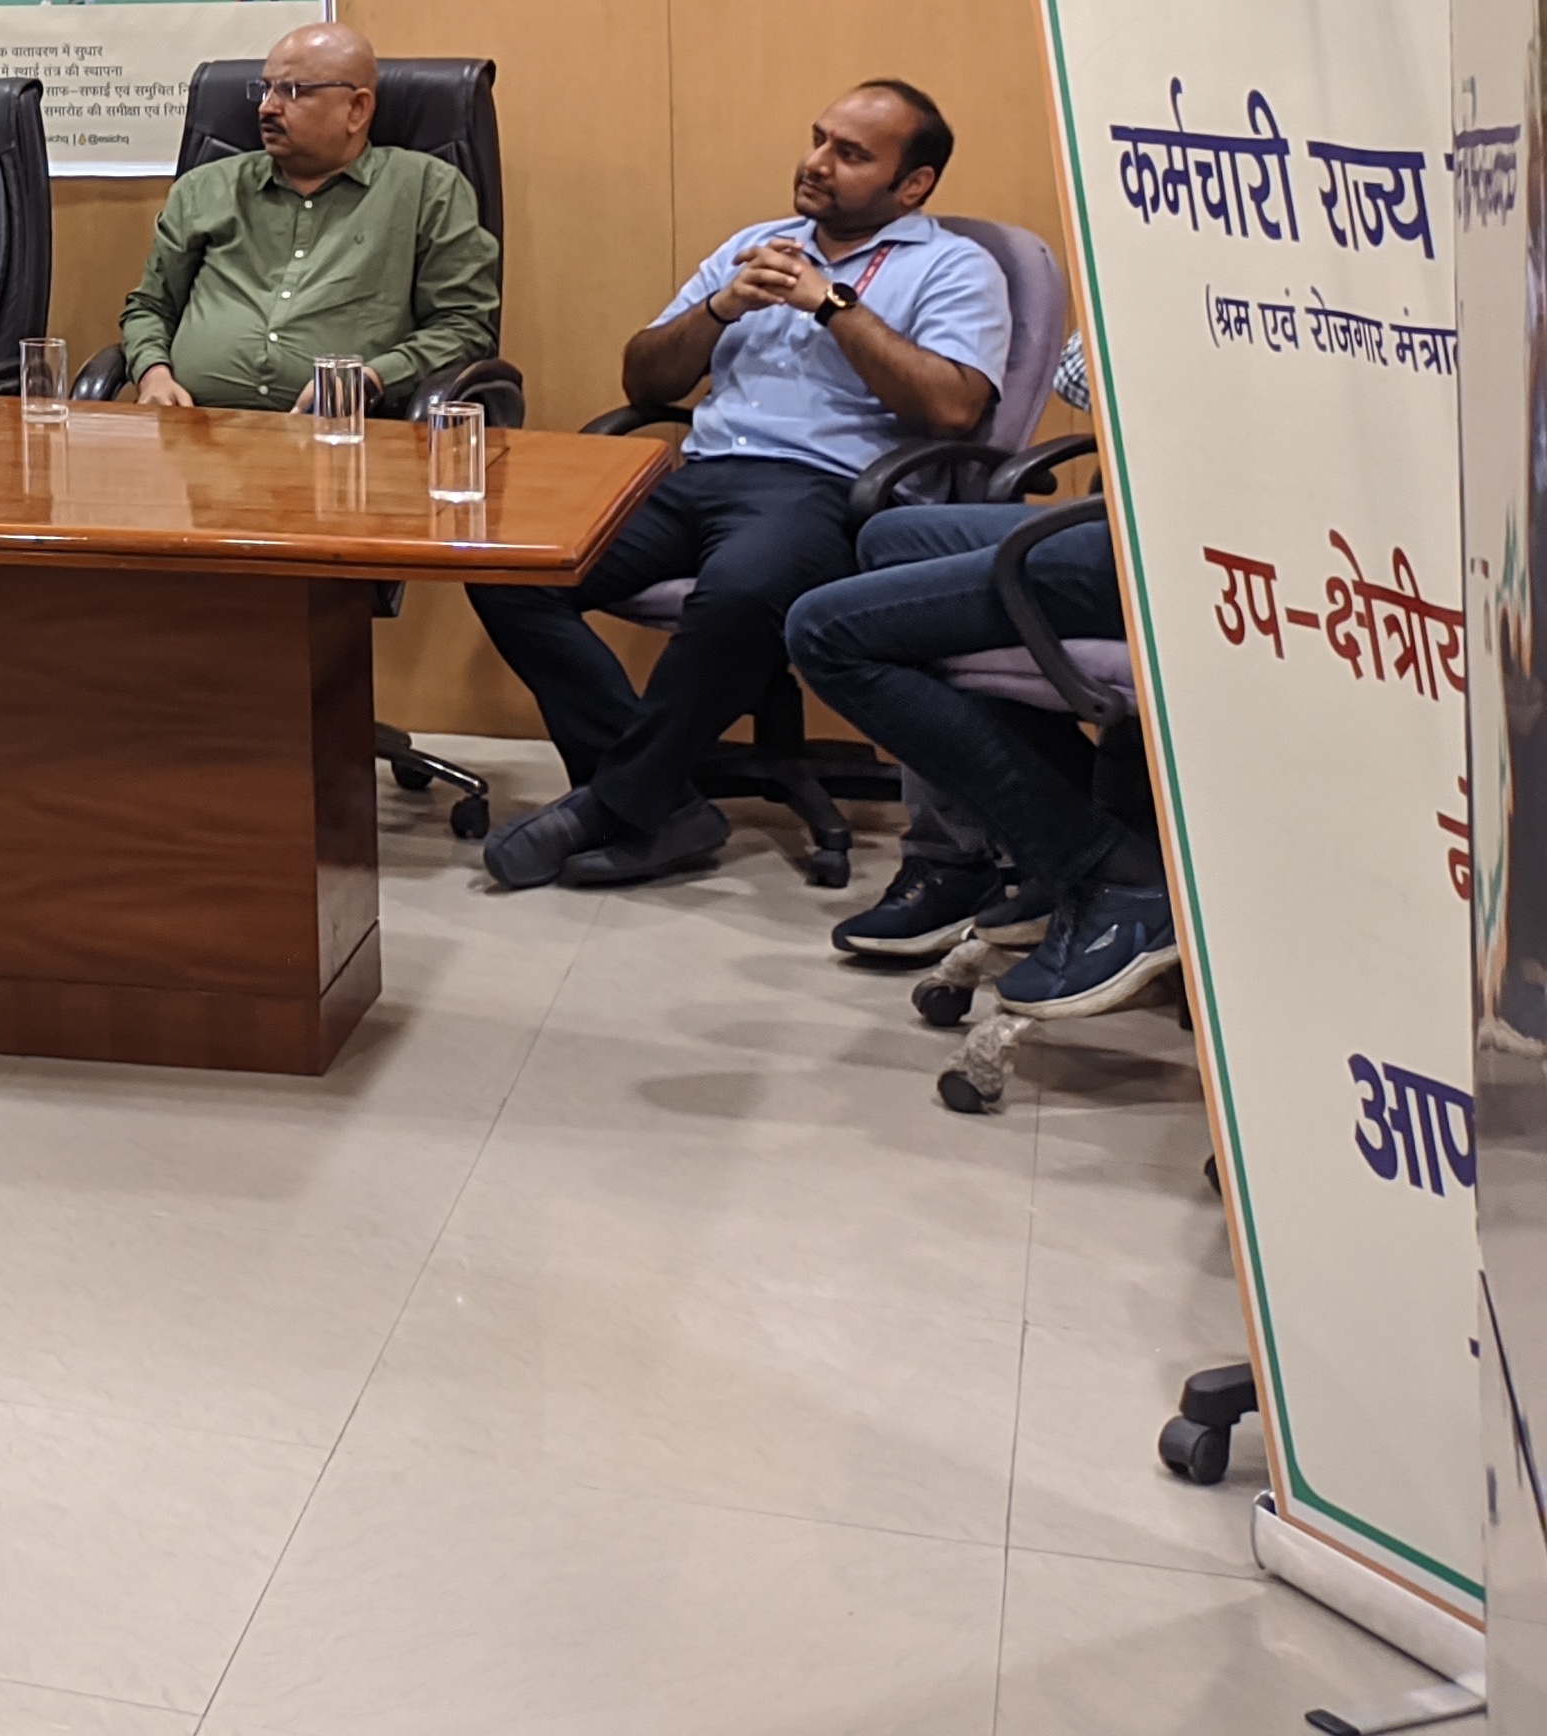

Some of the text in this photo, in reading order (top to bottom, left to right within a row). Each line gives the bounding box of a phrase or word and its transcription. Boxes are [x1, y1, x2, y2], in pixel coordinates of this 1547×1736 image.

[1110, 76, 1300, 243] कर्मचारी
[1306, 139, 1436, 261] राज्य
[1206, 283, 1254, 350] (श्रम
[1257, 288, 1300, 354] एवं
[1304, 286, 1389, 367] रोजगार
